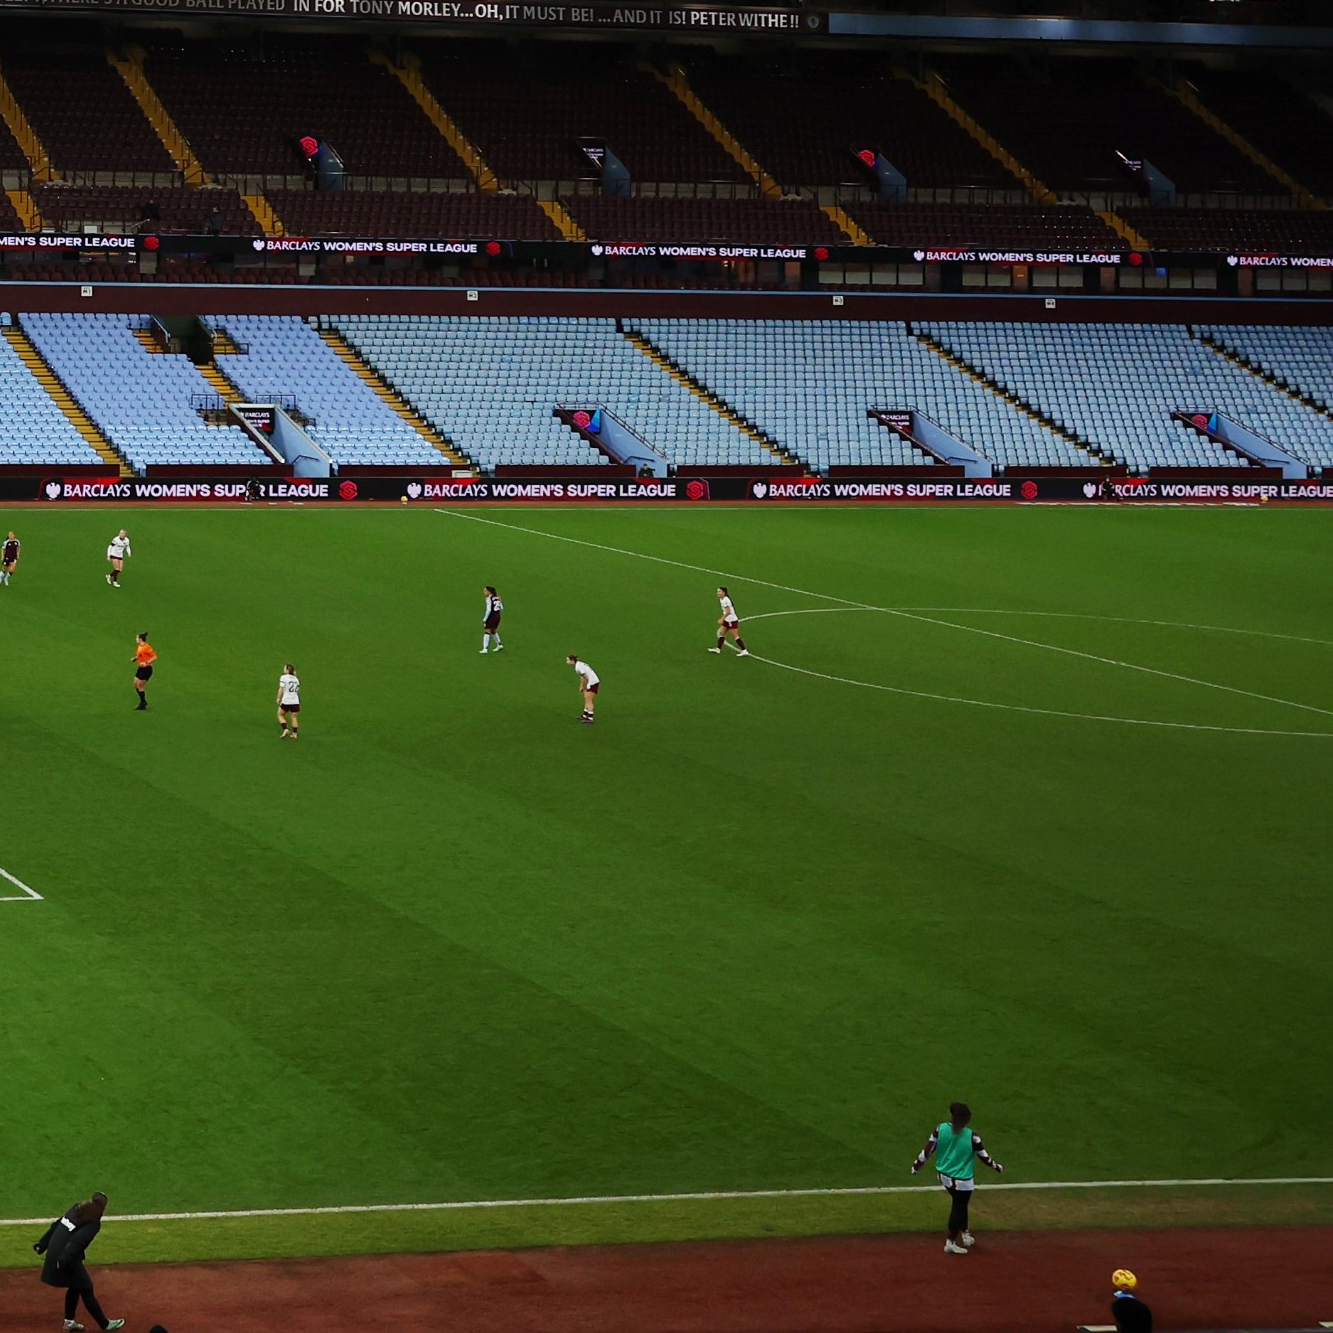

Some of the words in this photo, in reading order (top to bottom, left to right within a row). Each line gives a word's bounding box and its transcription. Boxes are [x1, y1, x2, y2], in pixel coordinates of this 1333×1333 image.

[350, 0, 396, 14] TONY
[505, 5, 520, 19] IT
[523, 6, 566, 20] MUST
[651, 10, 664, 24] IT
[691, 11, 736, 27] PETER
[39, 236, 83, 247] SUPER
[84, 237, 135, 248] LEAGUE
[266, 240, 321, 251] BARCLAYS
[323, 241, 384, 252] WOMEN'S
[386, 242, 428, 252] SUPER
[429, 243, 478, 253] LEAGUE
[604, 245, 656, 256] BARCLAYS
[658, 246, 717, 257] WOMEN'S
[718, 247, 759, 258] SUPER
[760, 248, 807, 258] LEAGUE
[926, 251, 976, 262] BARCLAYS
[978, 252, 1034, 263] WOMEN'S
[1036, 253, 1074, 264] SUPER
[1076, 254, 1121, 264] LEAGUE
[1239, 256, 1288, 267] BARCLAYS
[63, 484, 131, 498] BARCLAYS
[135, 483, 211, 497] WOMEN'S
[213, 483, 266, 497] SUPR
[269, 484, 329, 497] LEAGUE
[423, 484, 488, 498] BARCLAYS
[491, 484, 564, 497] WOMEN'S
[567, 484, 617, 497] SUPER
[619, 484, 676, 497] LEAGUE
[769, 484, 831, 497] BARCLAYS
[834, 483, 904, 496] WOMEN'S
[906, 483, 954, 497] SUPER
[956, 484, 1011, 497] LEAGUE
[1160, 484, 1229, 497] WOMEN'S
[1232, 485, 1278, 498] SUPER
